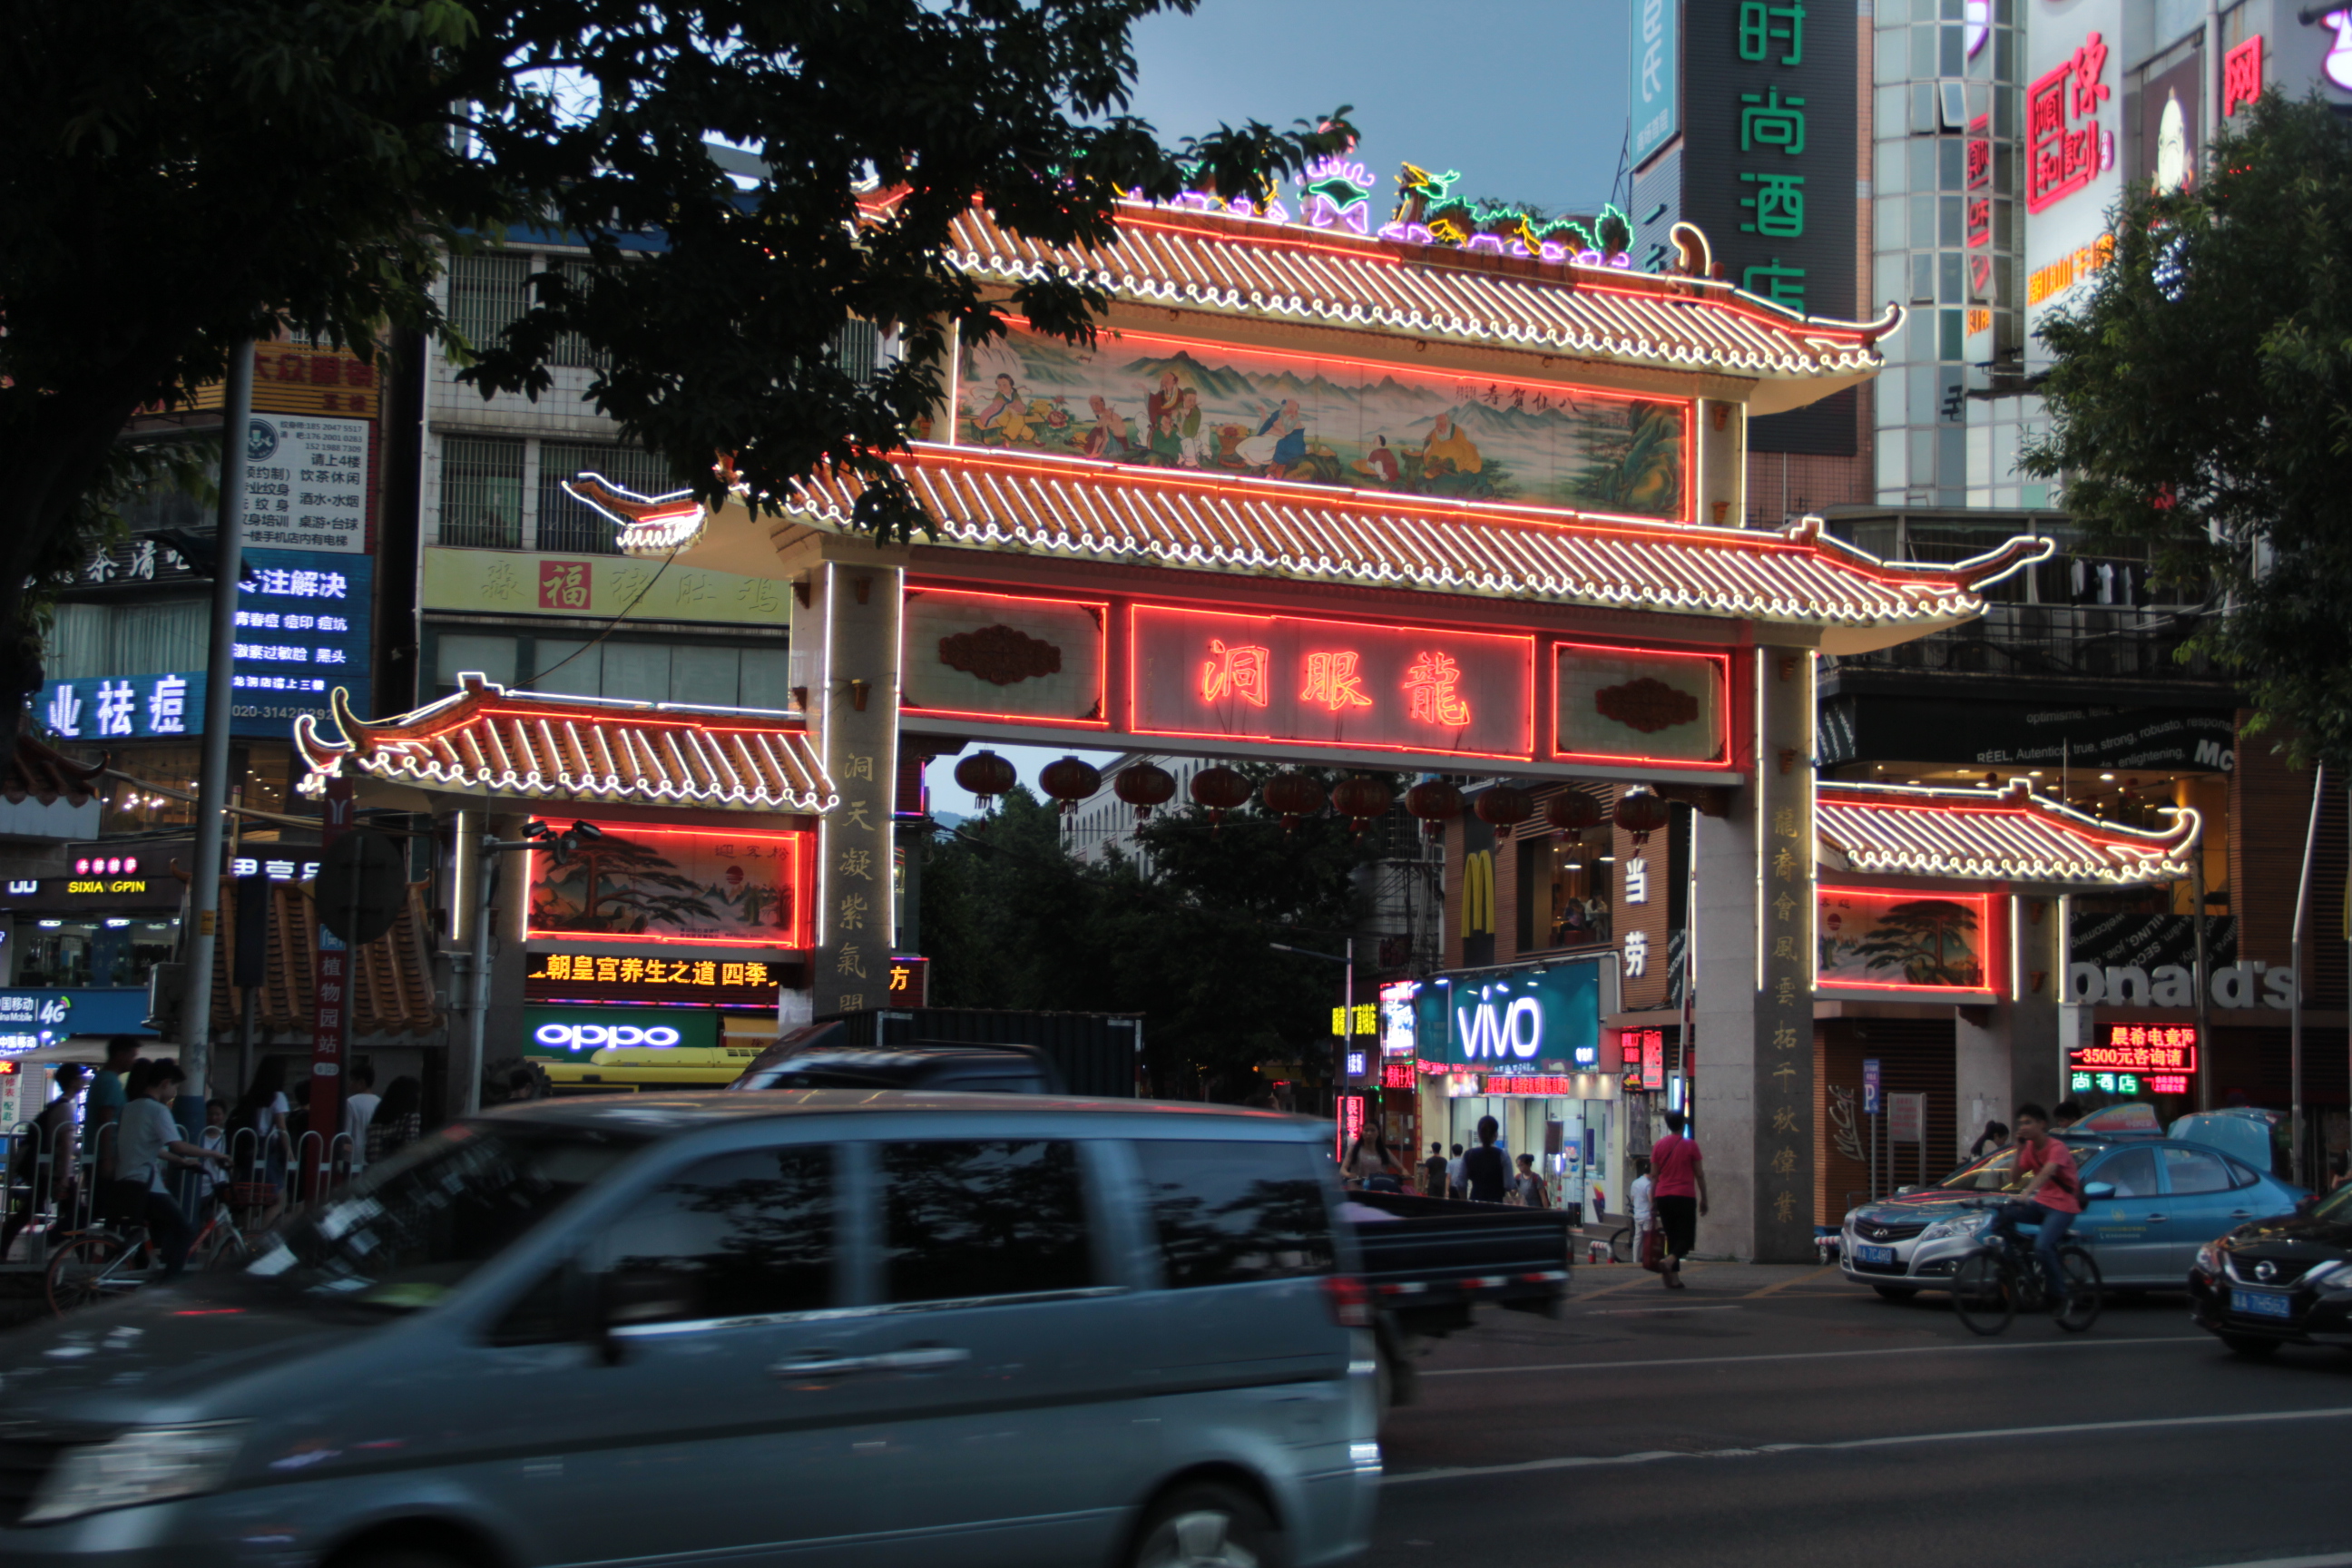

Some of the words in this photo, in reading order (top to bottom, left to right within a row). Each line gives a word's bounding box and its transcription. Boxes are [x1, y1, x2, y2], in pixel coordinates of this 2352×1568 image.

[322, 423, 342, 431] 2047
[322, 433, 342, 441] 2001
[343, 435, 362, 443] 0283
[322, 444, 341, 452] 1988
[311, 453, 361, 468] 请上4楼
[300, 468, 360, 485] 饮茶休闲
[234, 611, 280, 628] 青春痘
[283, 613, 314, 630] 痘印
[233, 643, 309, 662] 激素过敏脸
[316, 648, 347, 664] 黑头
[24, 674, 188, 739] 业祛痘
[2073, 742, 2098, 755] true,
[2101, 731, 2138, 750] strong,
[67, 880, 146, 894] SIXIANGPIN
[2070, 960, 2303, 1009] onad's
[40, 999, 66, 1024] 4G
[318, 956, 342, 1054] 植物园站
[1865, 1084, 1876, 1111] P
